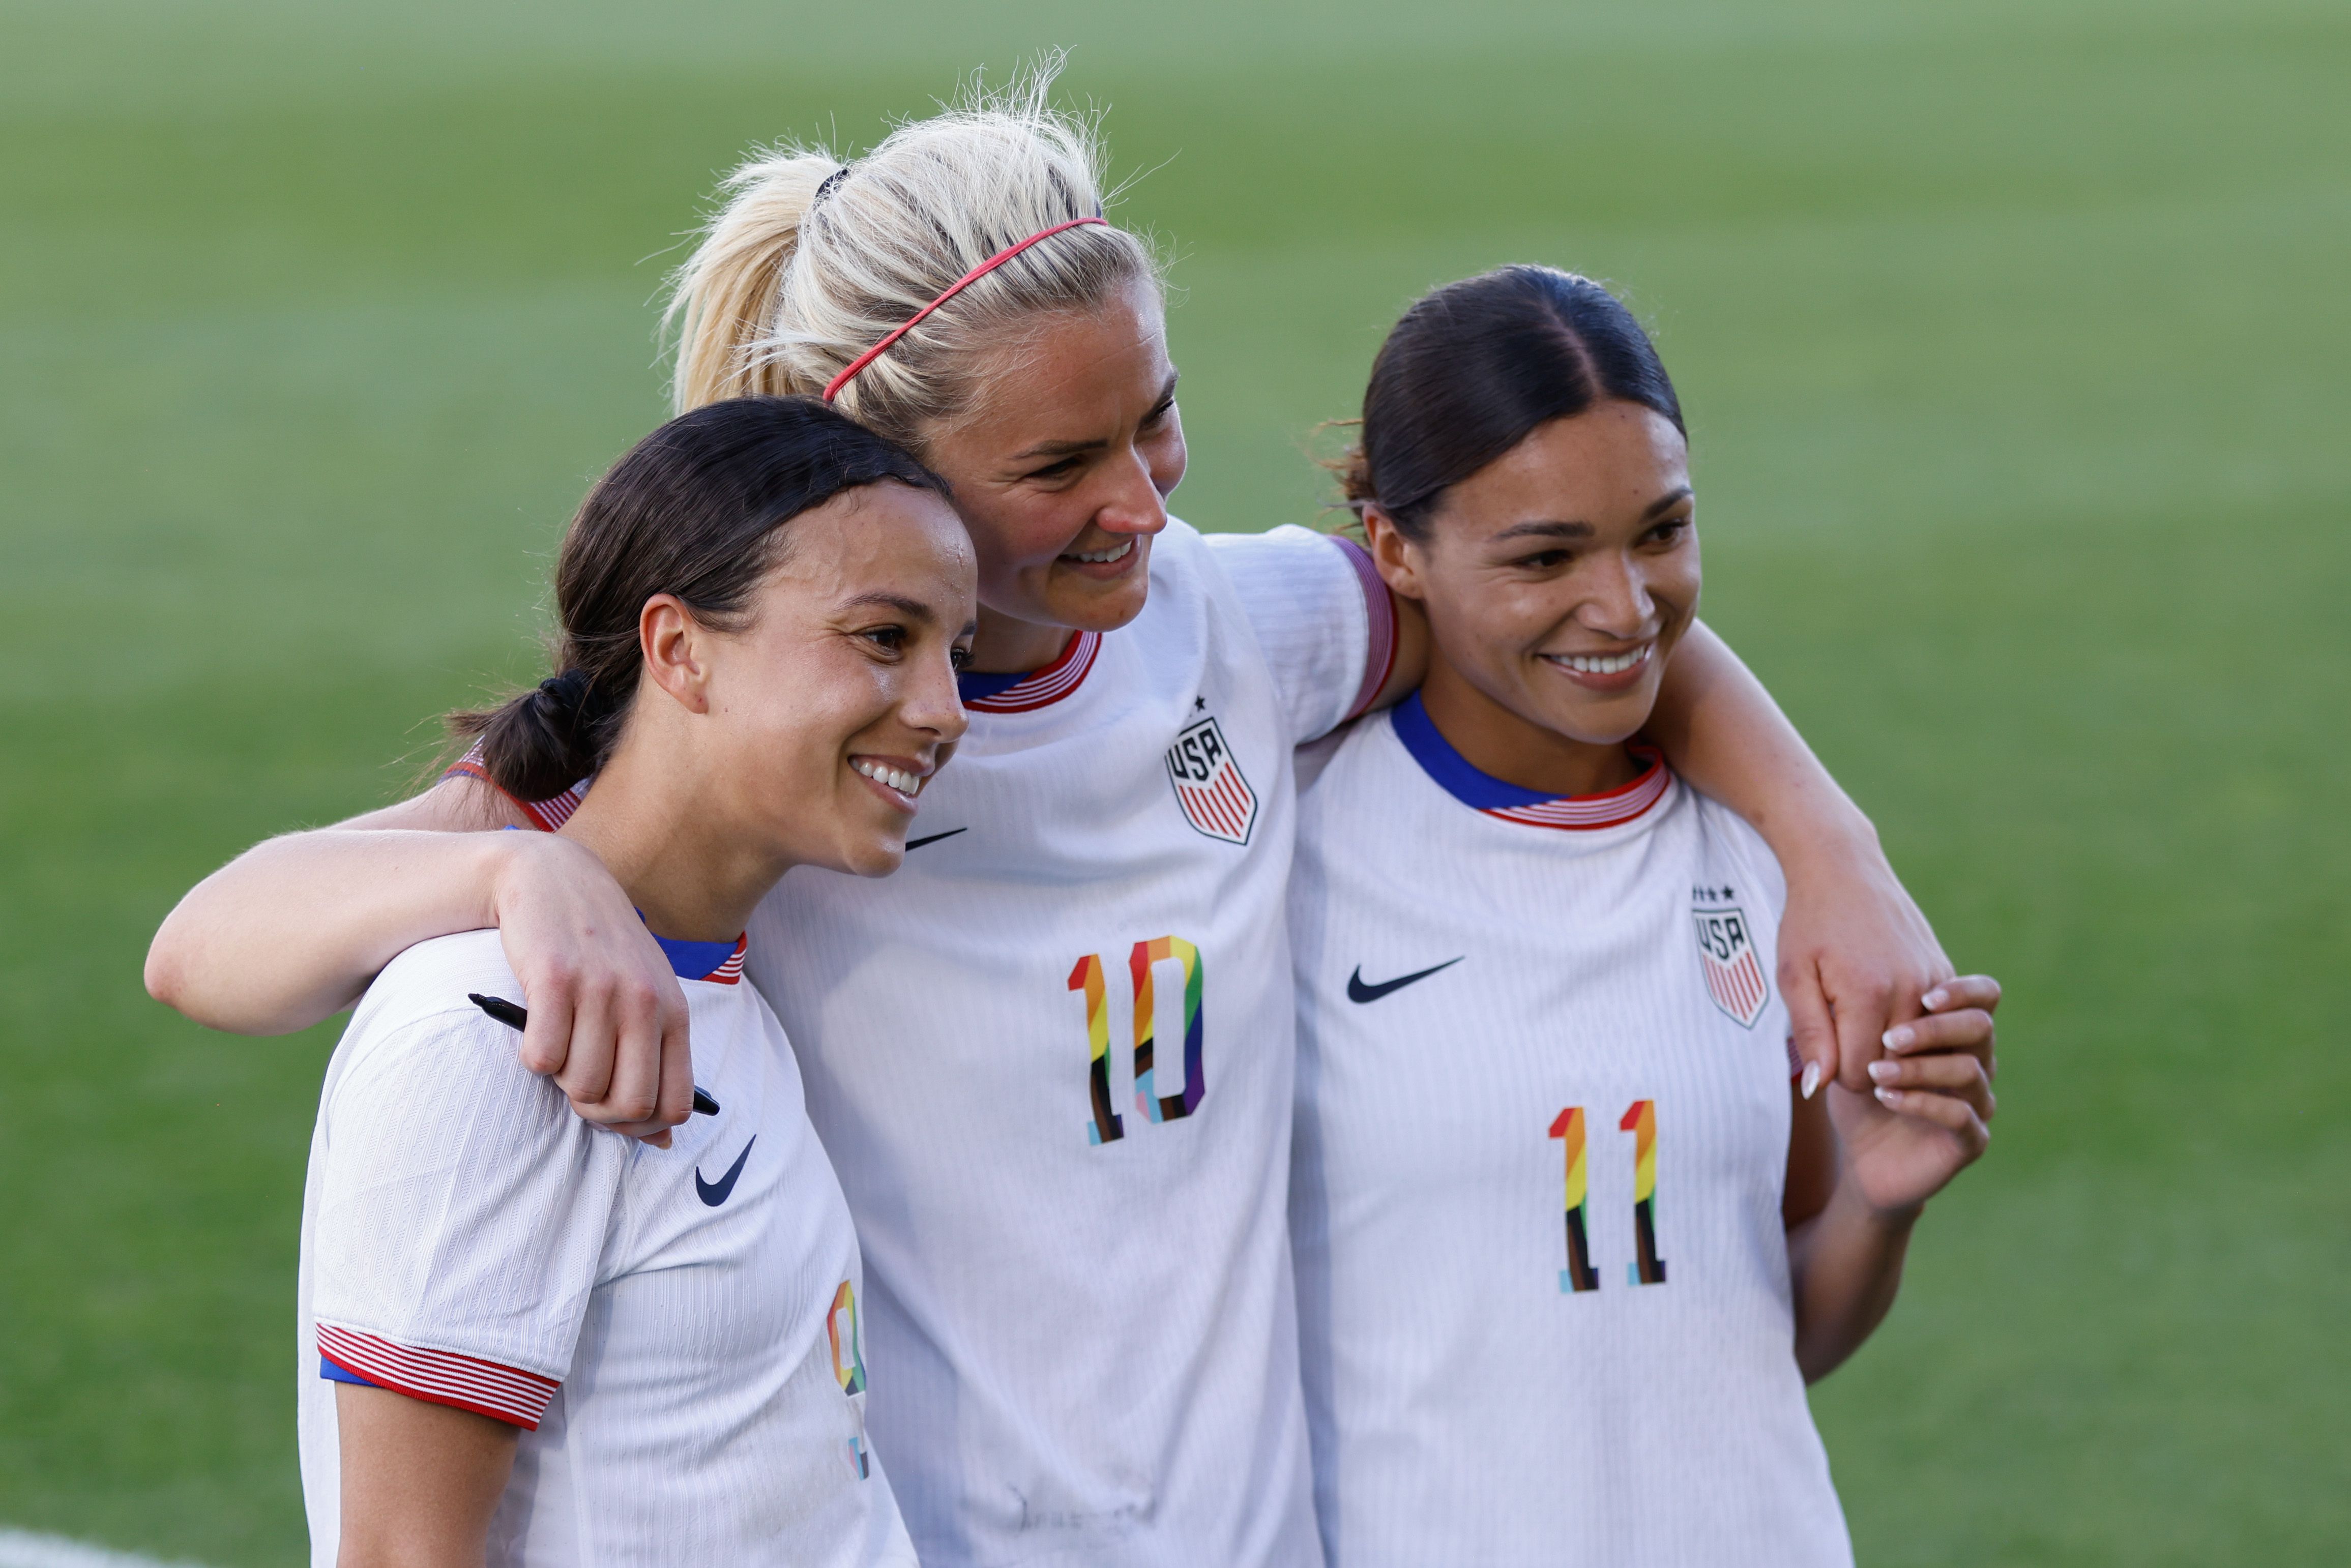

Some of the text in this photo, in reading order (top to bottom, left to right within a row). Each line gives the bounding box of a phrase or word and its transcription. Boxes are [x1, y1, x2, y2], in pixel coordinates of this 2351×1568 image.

[1168, 728, 1222, 781] USA
[1695, 918, 1744, 960] USA
[1067, 935, 1206, 1146] 10
[1548, 1099, 1666, 1293] 11
